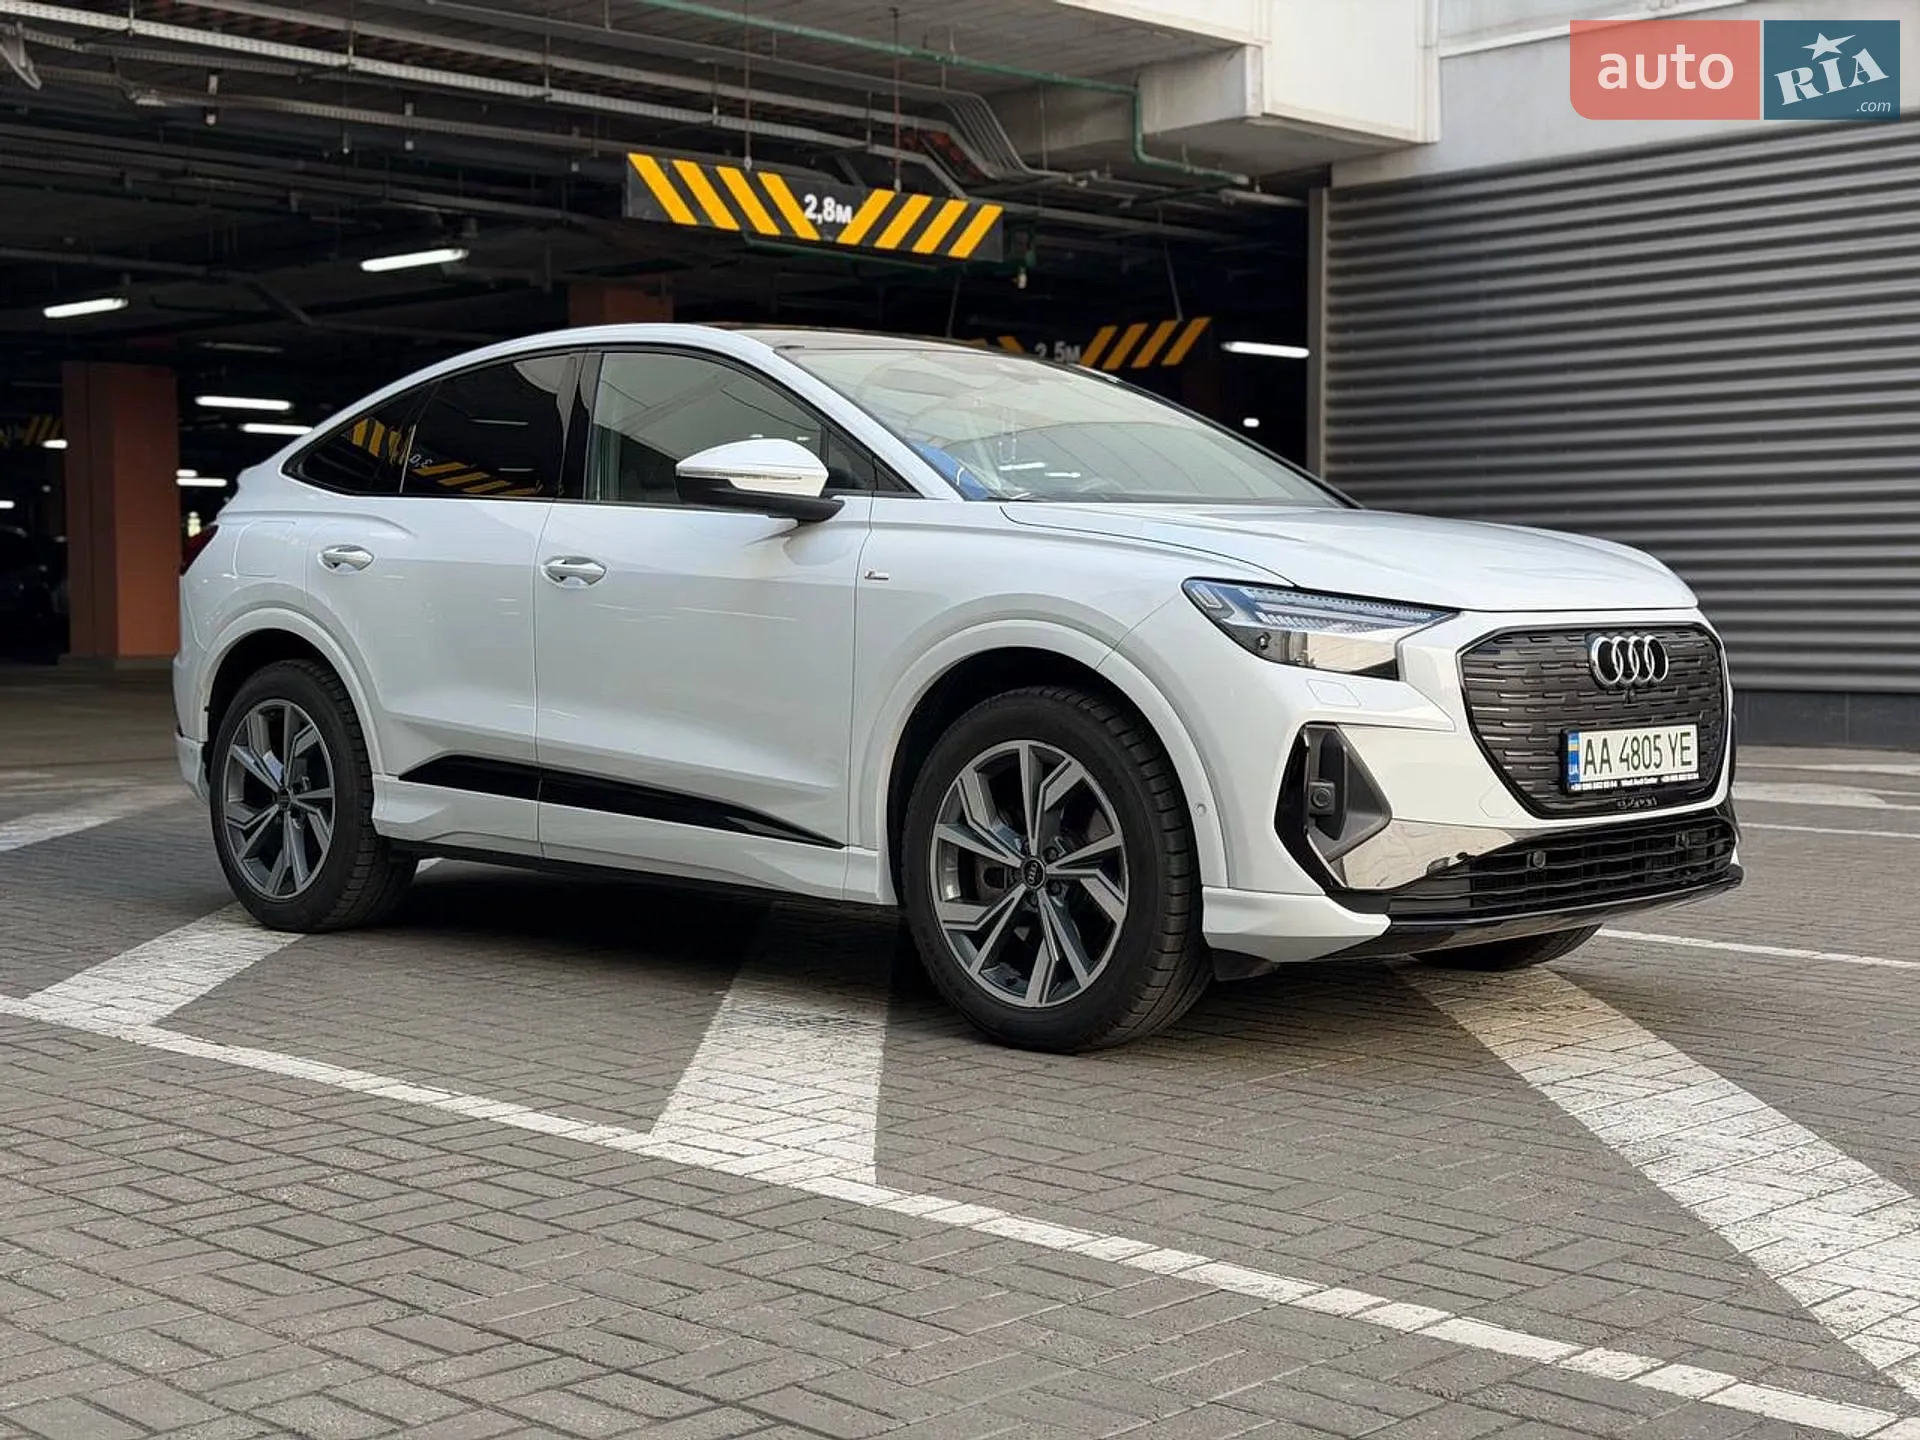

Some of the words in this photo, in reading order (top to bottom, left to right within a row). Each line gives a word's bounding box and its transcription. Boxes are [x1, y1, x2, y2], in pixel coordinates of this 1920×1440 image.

[1583, 738, 1612, 775] AA
[1619, 733, 1662, 772] 4805
[1668, 731, 1692, 767] YE
